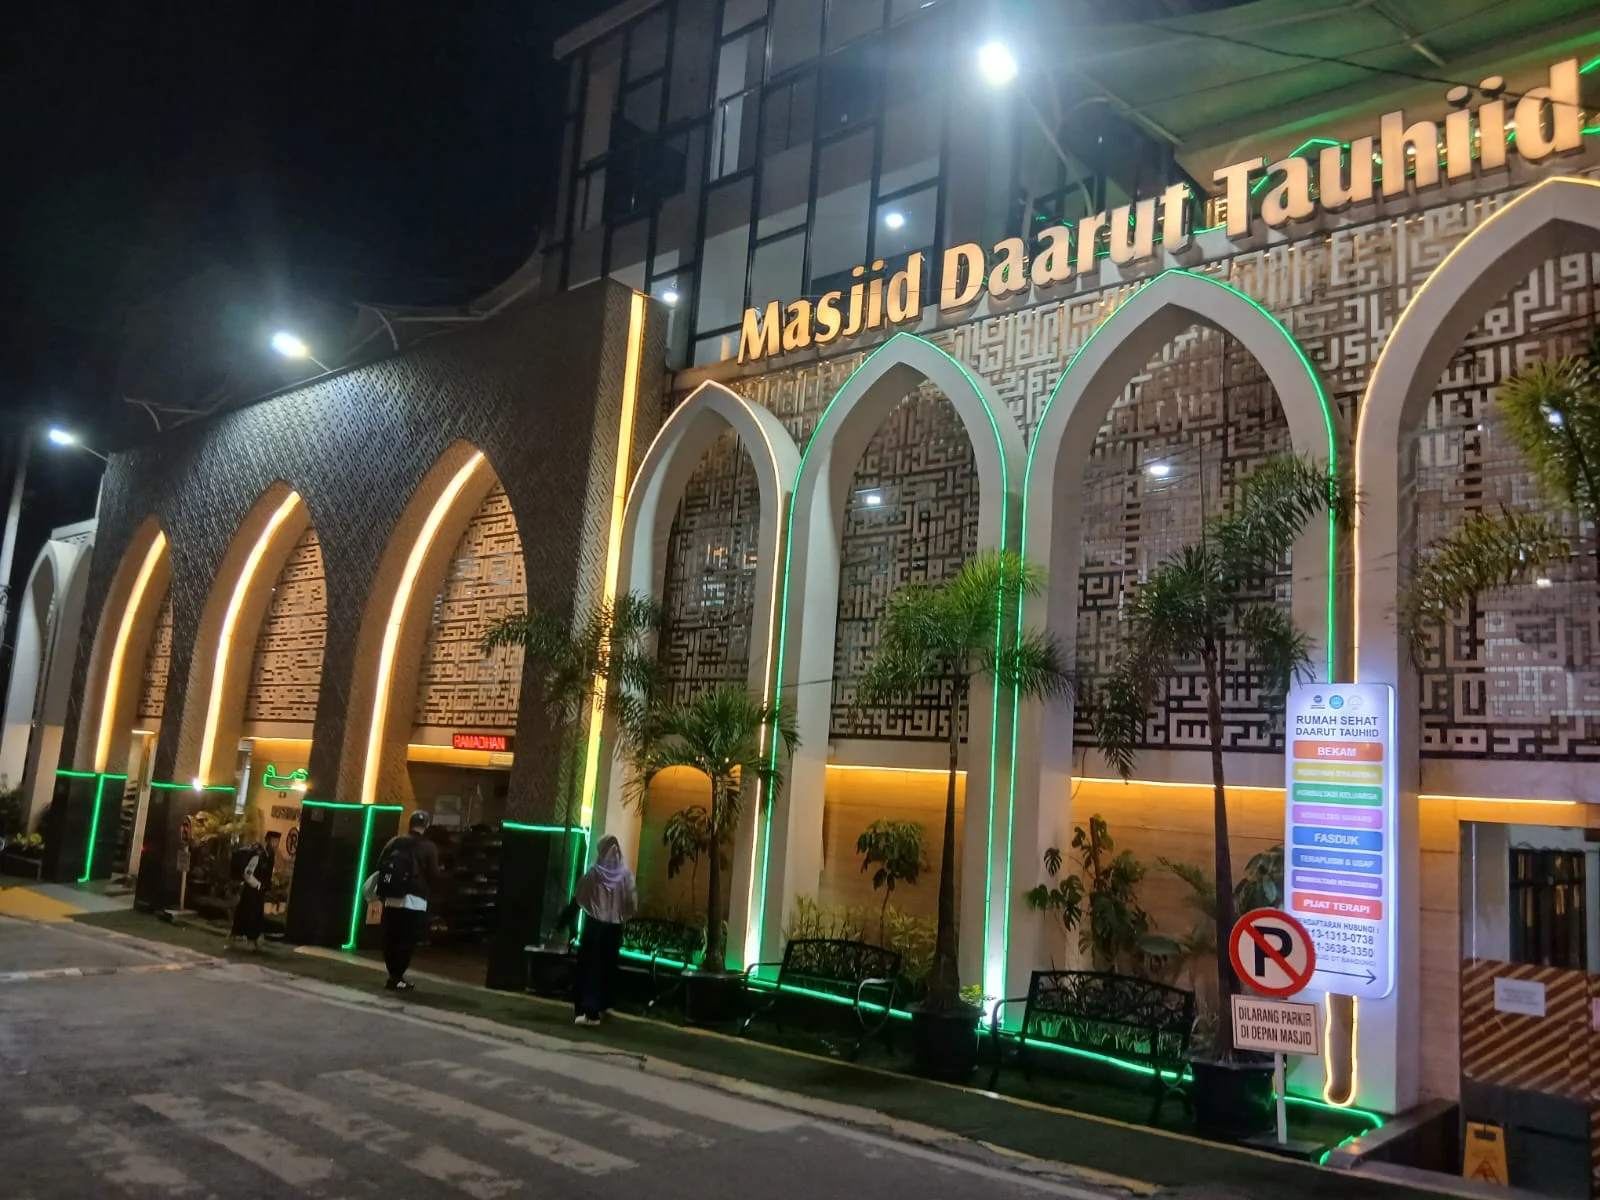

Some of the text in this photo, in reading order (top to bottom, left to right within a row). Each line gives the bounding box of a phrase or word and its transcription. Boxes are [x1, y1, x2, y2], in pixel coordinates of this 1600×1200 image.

[738, 58, 1585, 365] Masjid Daarut Tauhiid
[1296, 715, 1379, 726] RUMAH SEHAT
[1295, 727, 1379, 738] DAARUT TAUHIID
[1317, 746, 1357, 757] BEKAM
[1314, 833, 1359, 845] FASDUK
[1333, 902, 1371, 914] TERAPI
[1239, 1007, 1312, 1027] DILARANG PARKIR
[1240, 1025, 1312, 1046] DI DEPAN MASJID
